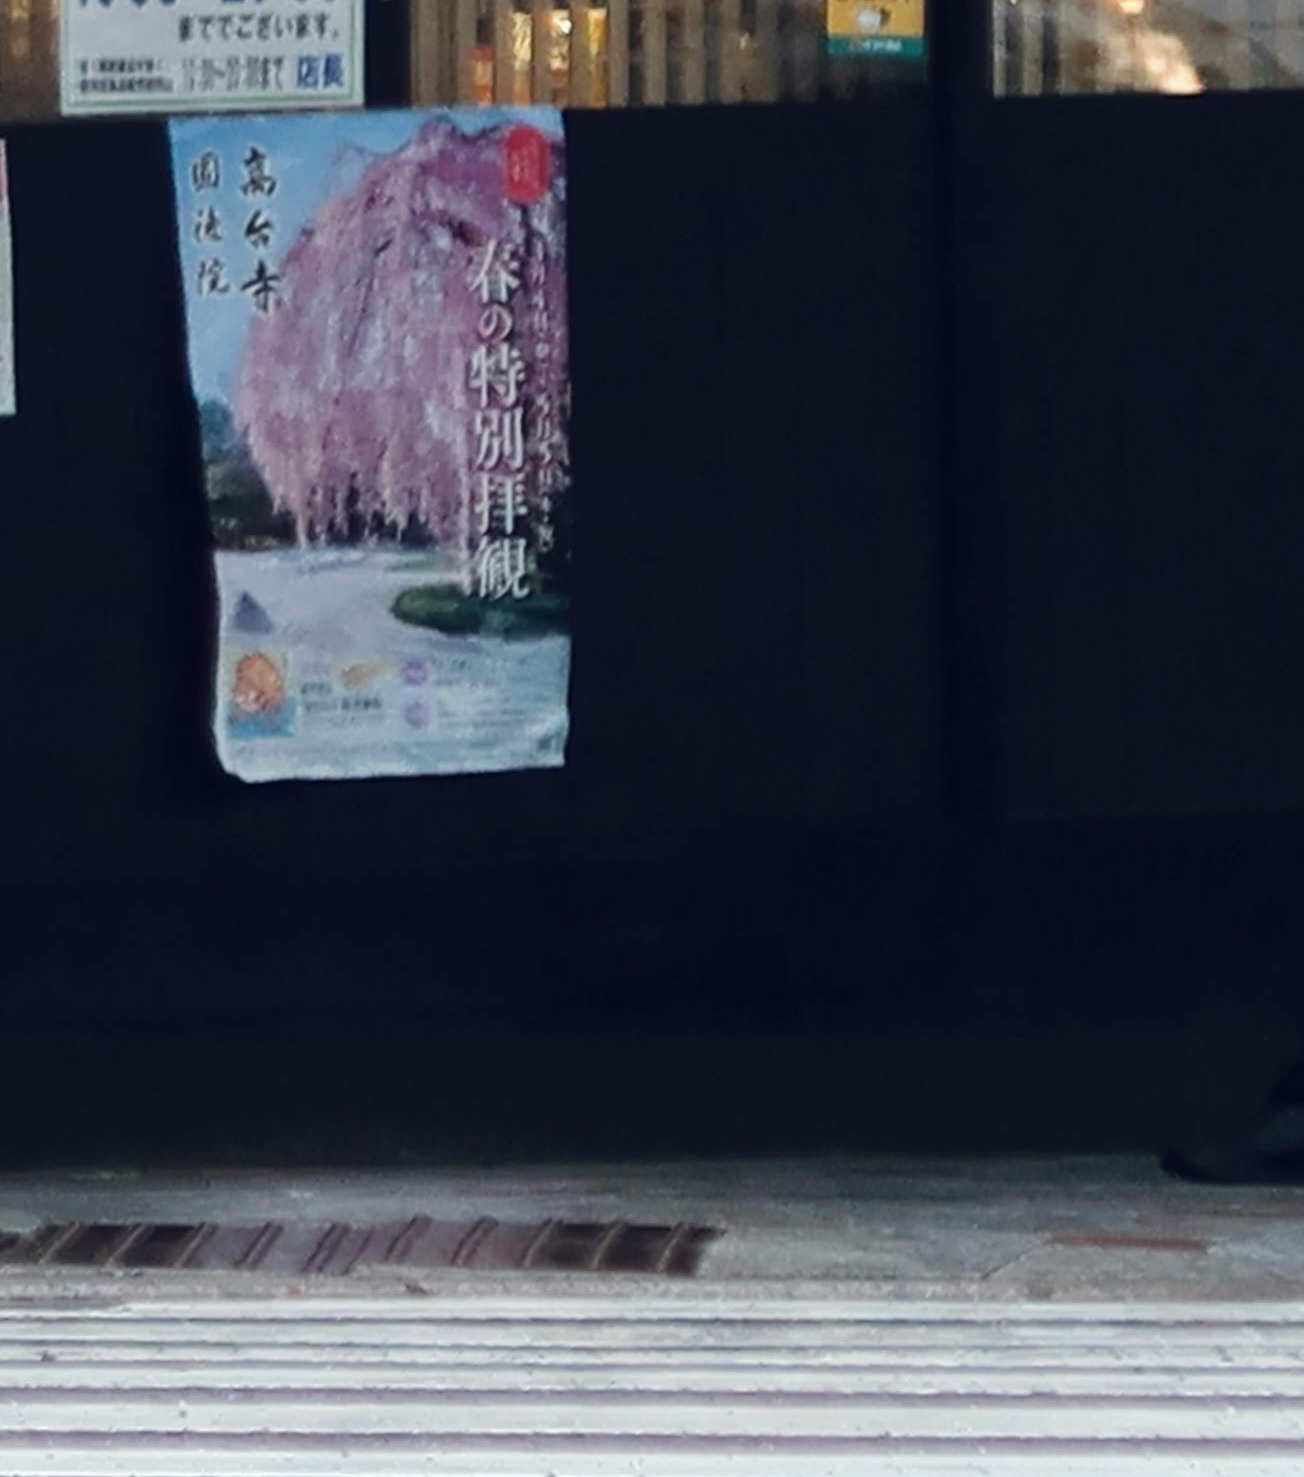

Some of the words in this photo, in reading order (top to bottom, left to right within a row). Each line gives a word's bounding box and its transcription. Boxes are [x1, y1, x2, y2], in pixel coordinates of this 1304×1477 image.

[238, 145, 283, 314] 高台寺
[469, 236, 531, 602] 春の特別拝観
